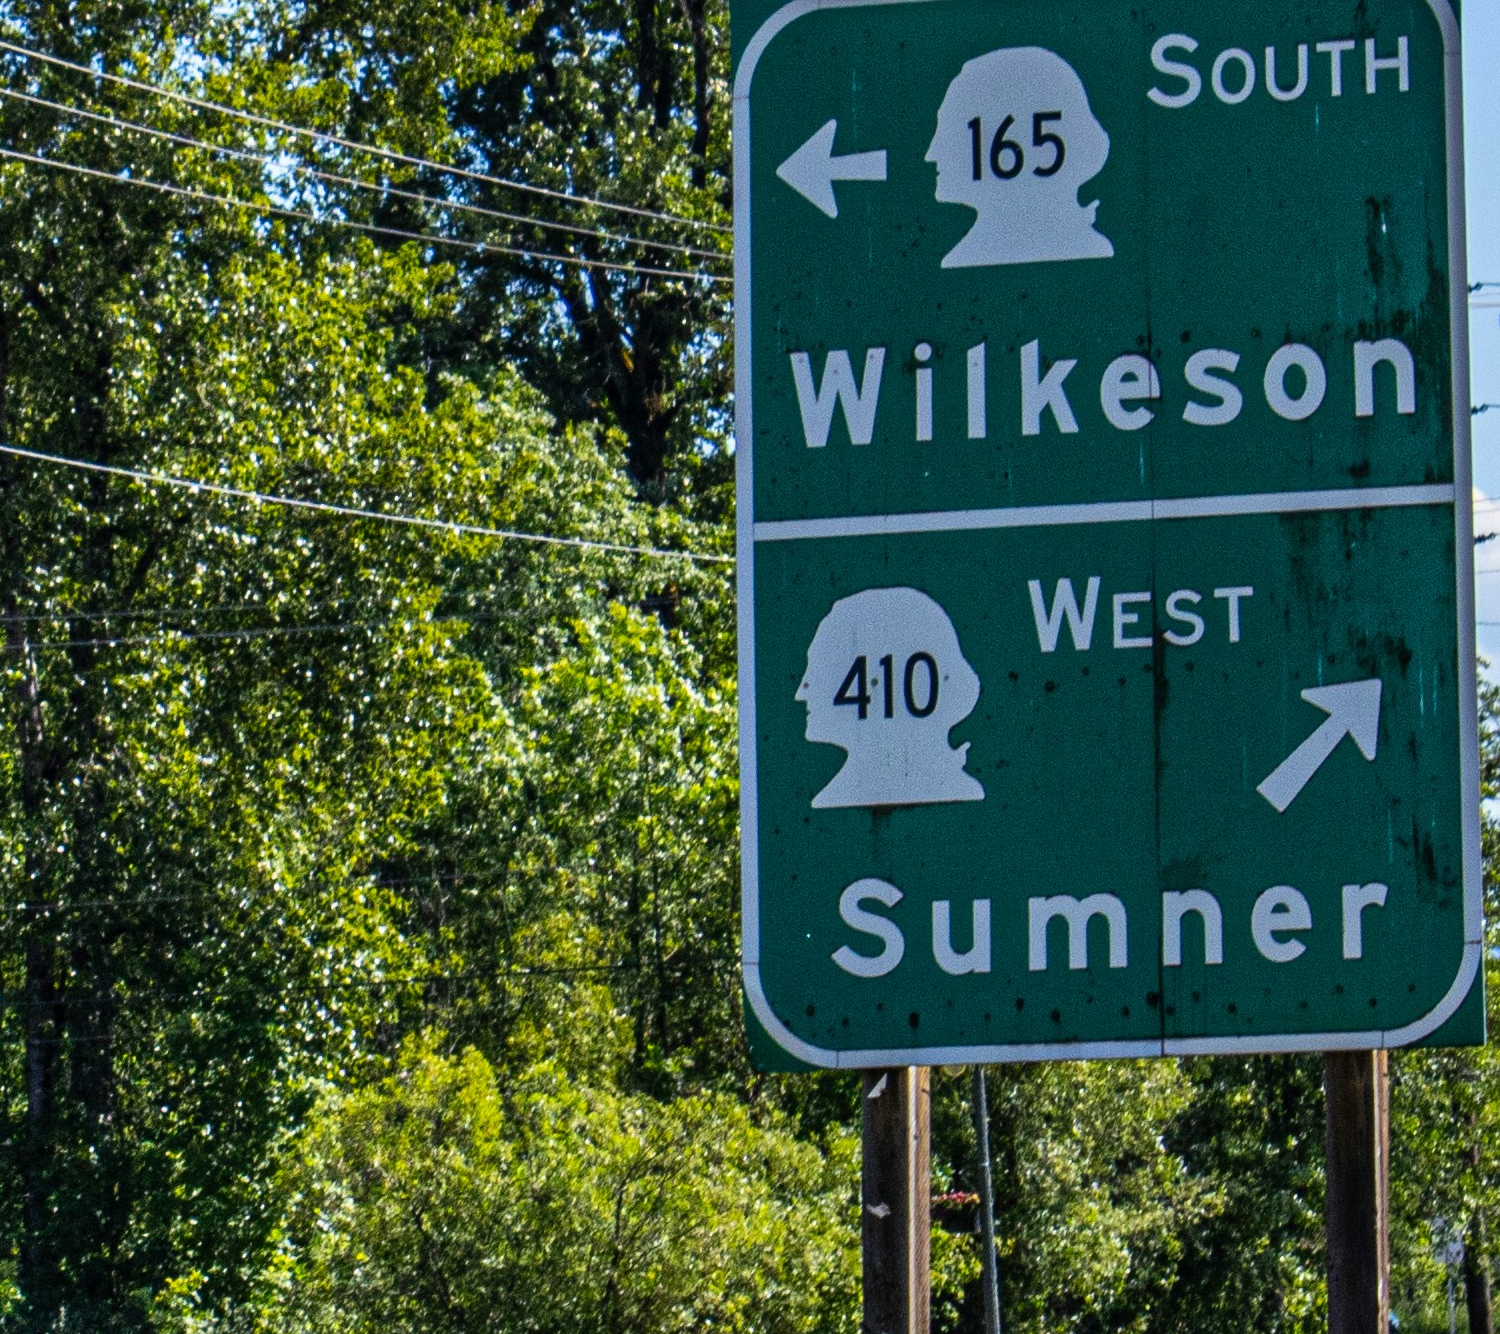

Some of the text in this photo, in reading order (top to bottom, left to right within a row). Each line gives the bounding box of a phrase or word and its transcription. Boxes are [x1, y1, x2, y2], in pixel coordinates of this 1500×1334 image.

[1147, 34, 1409, 108] SOUTH
[967, 111, 1065, 181] 165
[789, 338, 1416, 448] Wilkeson
[1028, 576, 1254, 653] WEST
[832, 651, 939, 721] 410
[832, 878, 1388, 978] Sumner
